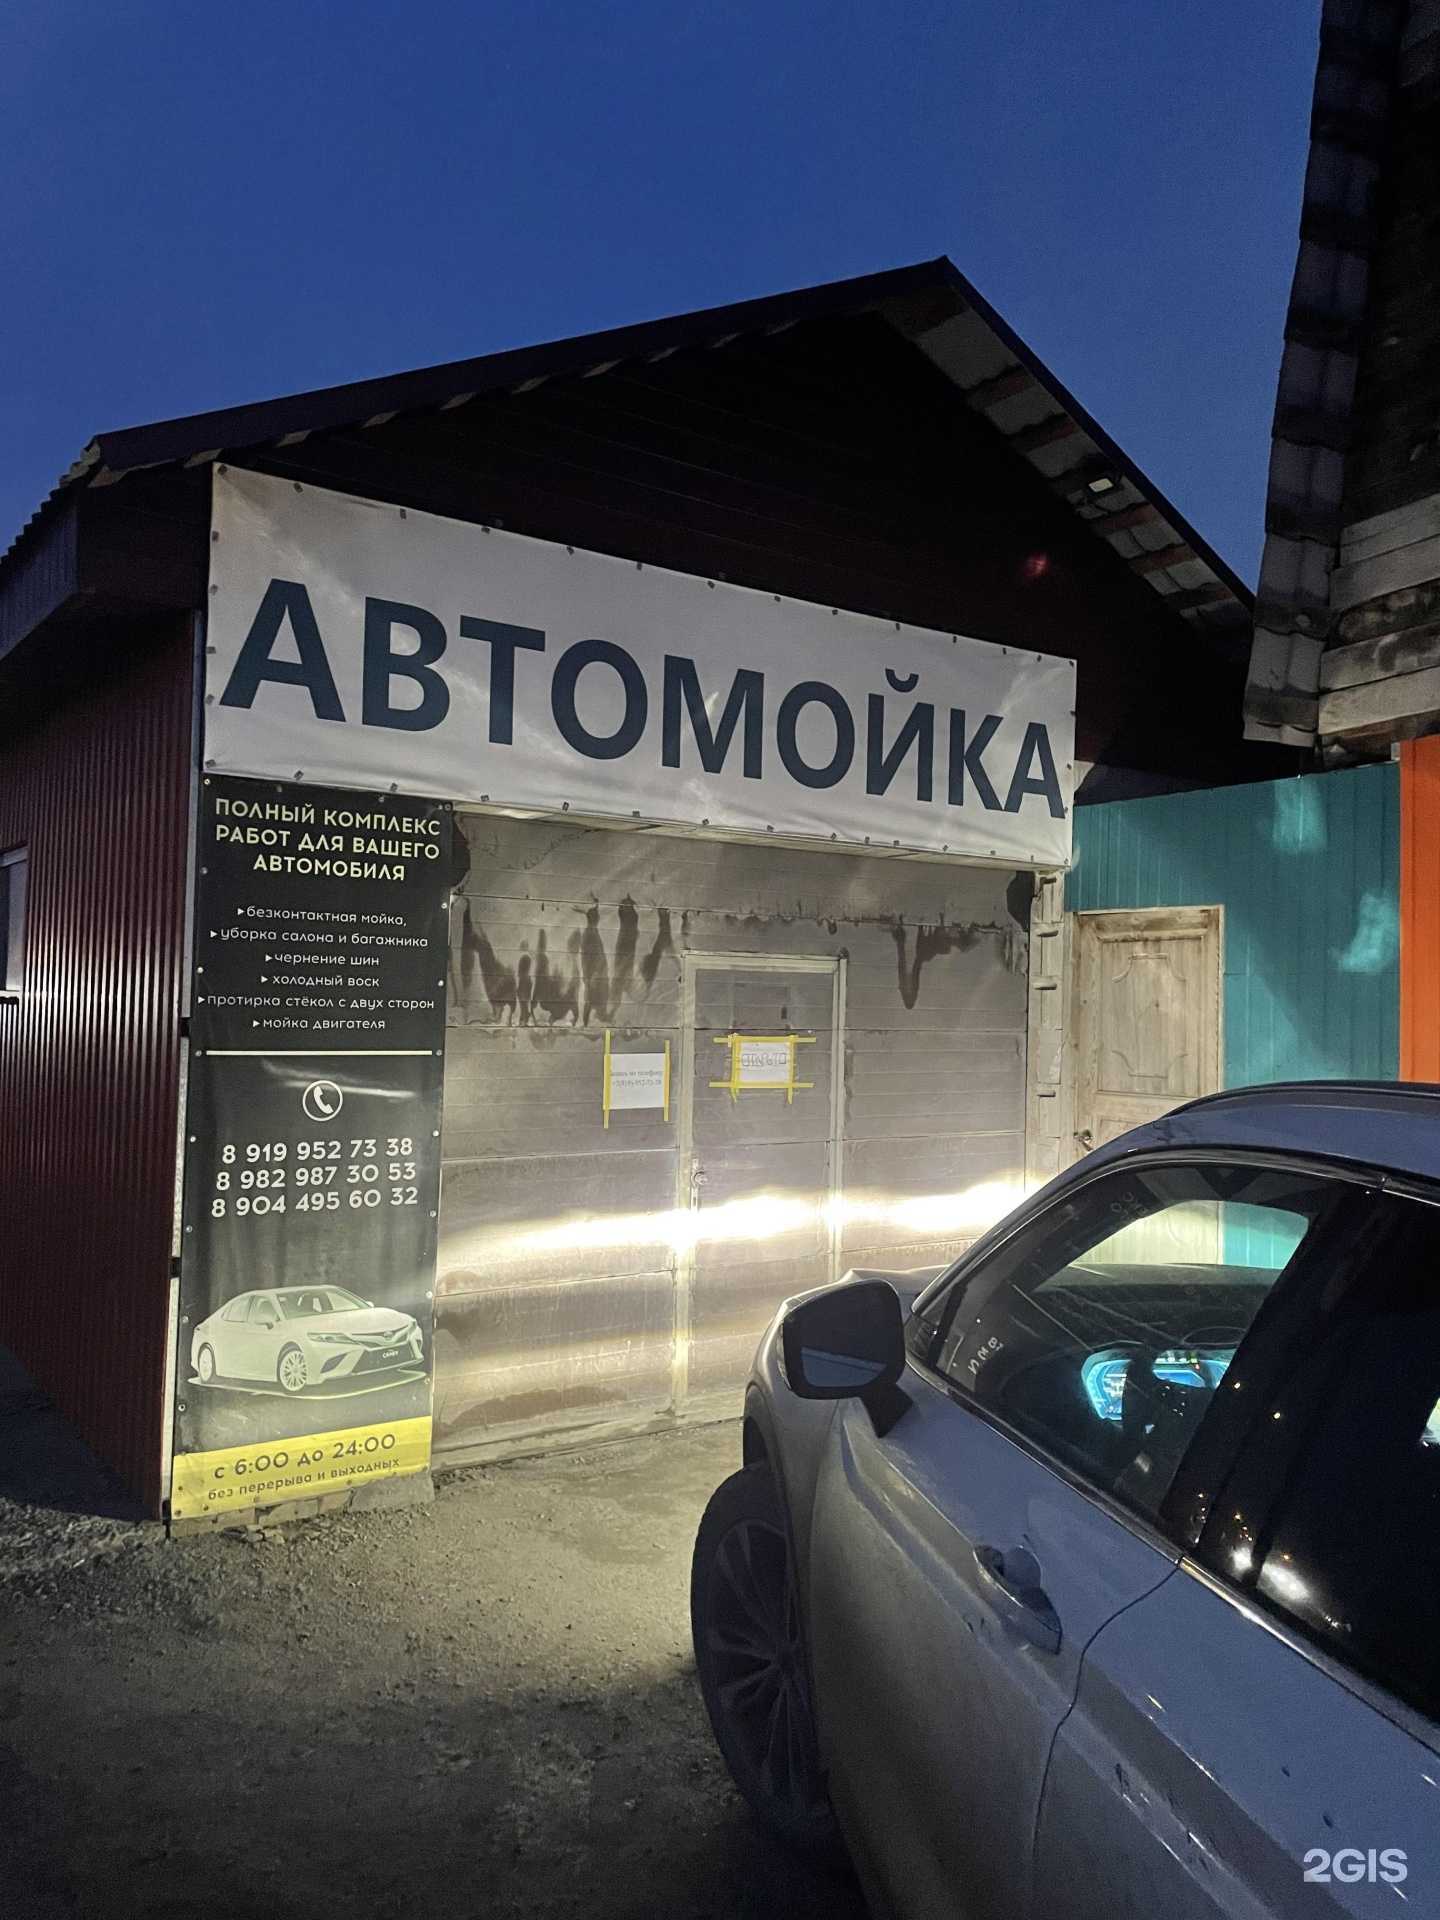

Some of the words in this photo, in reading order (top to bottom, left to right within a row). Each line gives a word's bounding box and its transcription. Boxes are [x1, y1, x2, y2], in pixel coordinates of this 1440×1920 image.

[219, 579, 1067, 820] АВТОМОЙКА
[215, 798, 315, 825] ПОЛНЫЙ
[324, 809, 441, 836] КОМПЛЕКС
[215, 825, 291, 847] РАБОТ
[298, 833, 344, 852] ДЛЯ
[352, 837, 440, 860] ВАШЕГО
[253, 854, 406, 881] АВТОМОБИЛЯ
[246, 906, 357, 922] безконтактная
[361, 913, 407, 927] мойка,
[220, 927, 277, 942] уборка
[282, 932, 334, 943] салона
[338, 935, 347, 943] и
[351, 933, 428, 947] багажника
[274, 953, 346, 966] чернение
[350, 956, 380, 966] шин
[272, 975, 343, 986] холодный
[347, 976, 380, 987] воск
[207, 995, 281, 1008] протирка
[338, 999, 346, 1008] с
[350, 999, 384, 1011] двух
[387, 998, 434, 1011] сторон
[263, 1016, 308, 1029] мойка
[312, 1018, 385, 1030] двигателя
[221, 1144, 236, 1164] 8
[246, 1142, 287, 1163] 919
[296, 1140, 342, 1161] 952
[350, 1138, 377, 1158] 73
[385, 1137, 413, 1157] 38
[216, 1172, 230, 1191] 8
[240, 1168, 286, 1190] 982
[295, 1166, 338, 1187] 987
[346, 1164, 379, 1184] 30
[388, 1162, 416, 1182] 53
[211, 1198, 226, 1218] 8
[236, 1195, 287, 1216] 904
[295, 1191, 340, 1212] 495
[349, 1189, 381, 1209] 60
[390, 1186, 418, 1206] 32
[234, 1452, 289, 1476] 6:00
[296, 1448, 324, 1468] до
[332, 1433, 396, 1459] 24:00
[208, 1487, 233, 1501] без
[239, 1473, 312, 1496] перерыва
[317, 1471, 326, 1481] и
[330, 1458, 401, 1479] выходных
